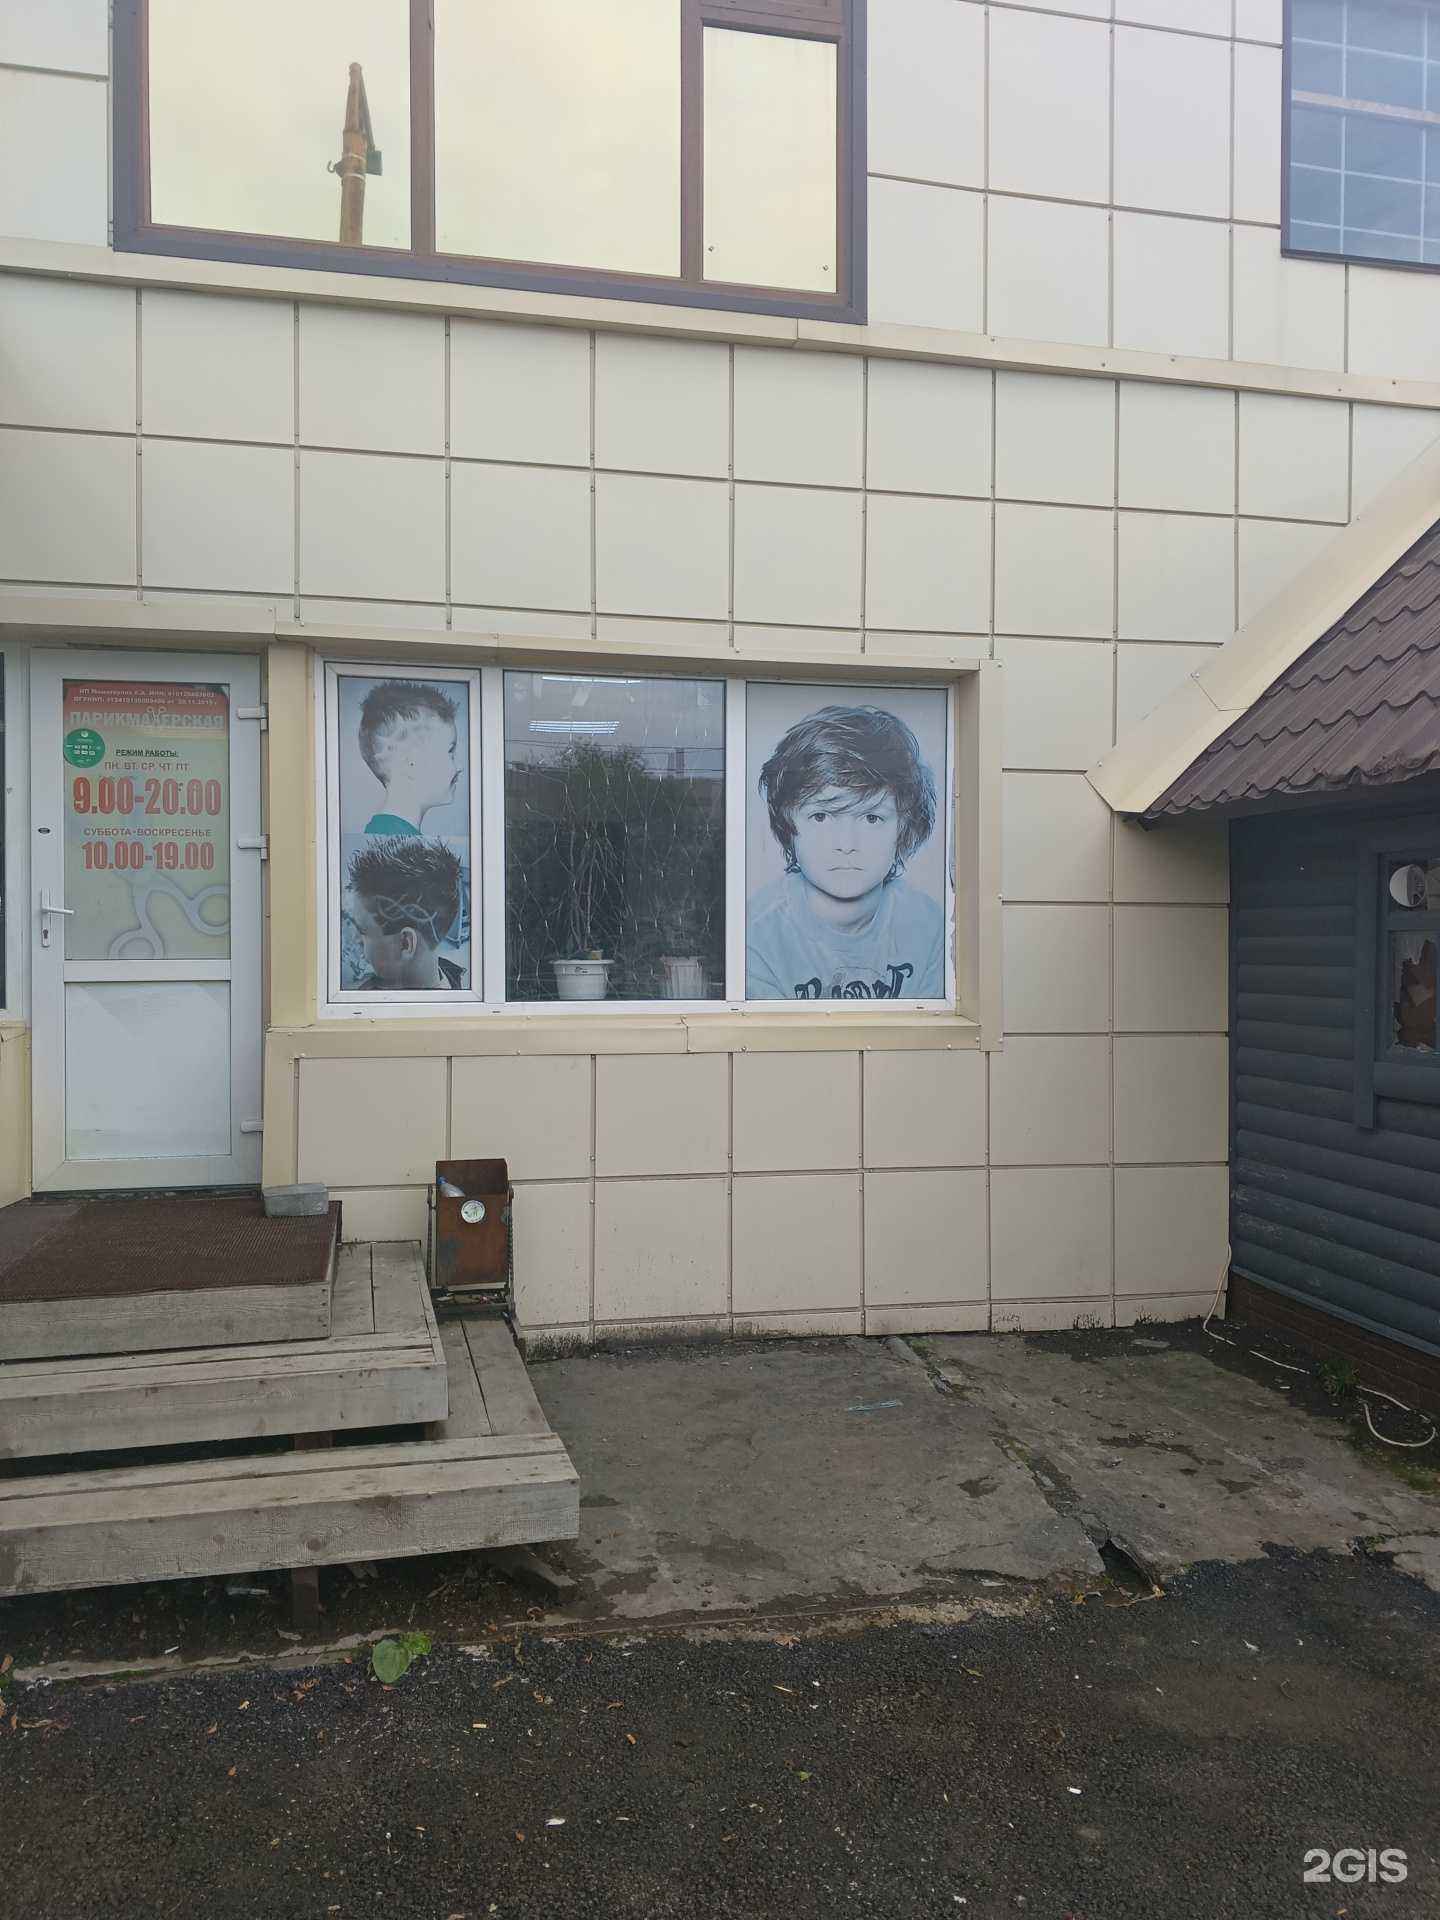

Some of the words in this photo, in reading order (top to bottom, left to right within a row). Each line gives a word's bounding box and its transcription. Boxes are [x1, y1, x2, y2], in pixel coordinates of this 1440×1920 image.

[69, 710, 224, 730] ПАРИКМАХЕРСКАЯ
[115, 749, 144, 757] РЕЖИМ
[73, 776, 222, 816] 9.00-20.00
[81, 841, 215, 871] 10.00-19.00
